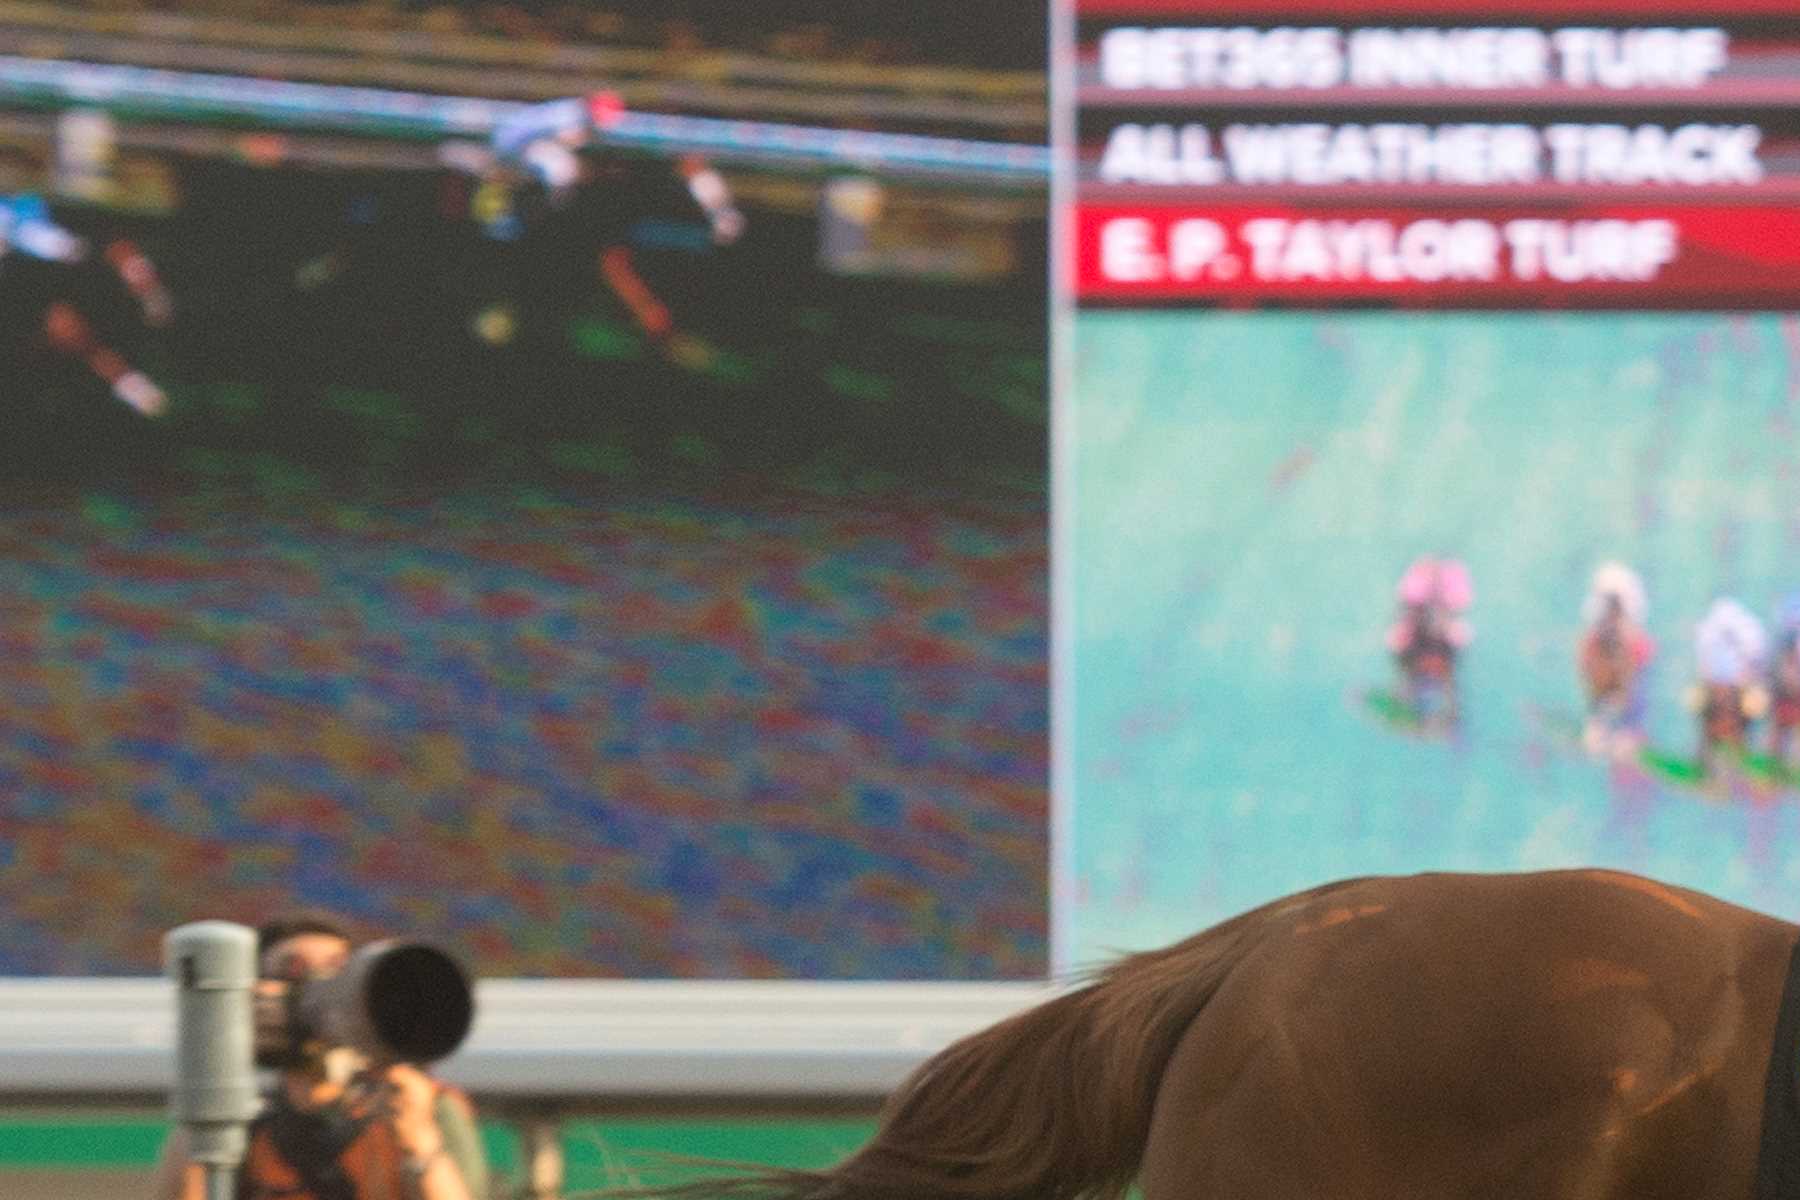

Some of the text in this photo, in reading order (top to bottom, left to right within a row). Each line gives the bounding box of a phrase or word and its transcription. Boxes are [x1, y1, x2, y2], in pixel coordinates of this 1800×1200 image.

[1100, 27, 1728, 90] BET365 INNER TURF
[1100, 124, 1763, 184] ALL WEATHER TRACK
[1102, 218, 1677, 281] E. P. TAYLOR TURF
